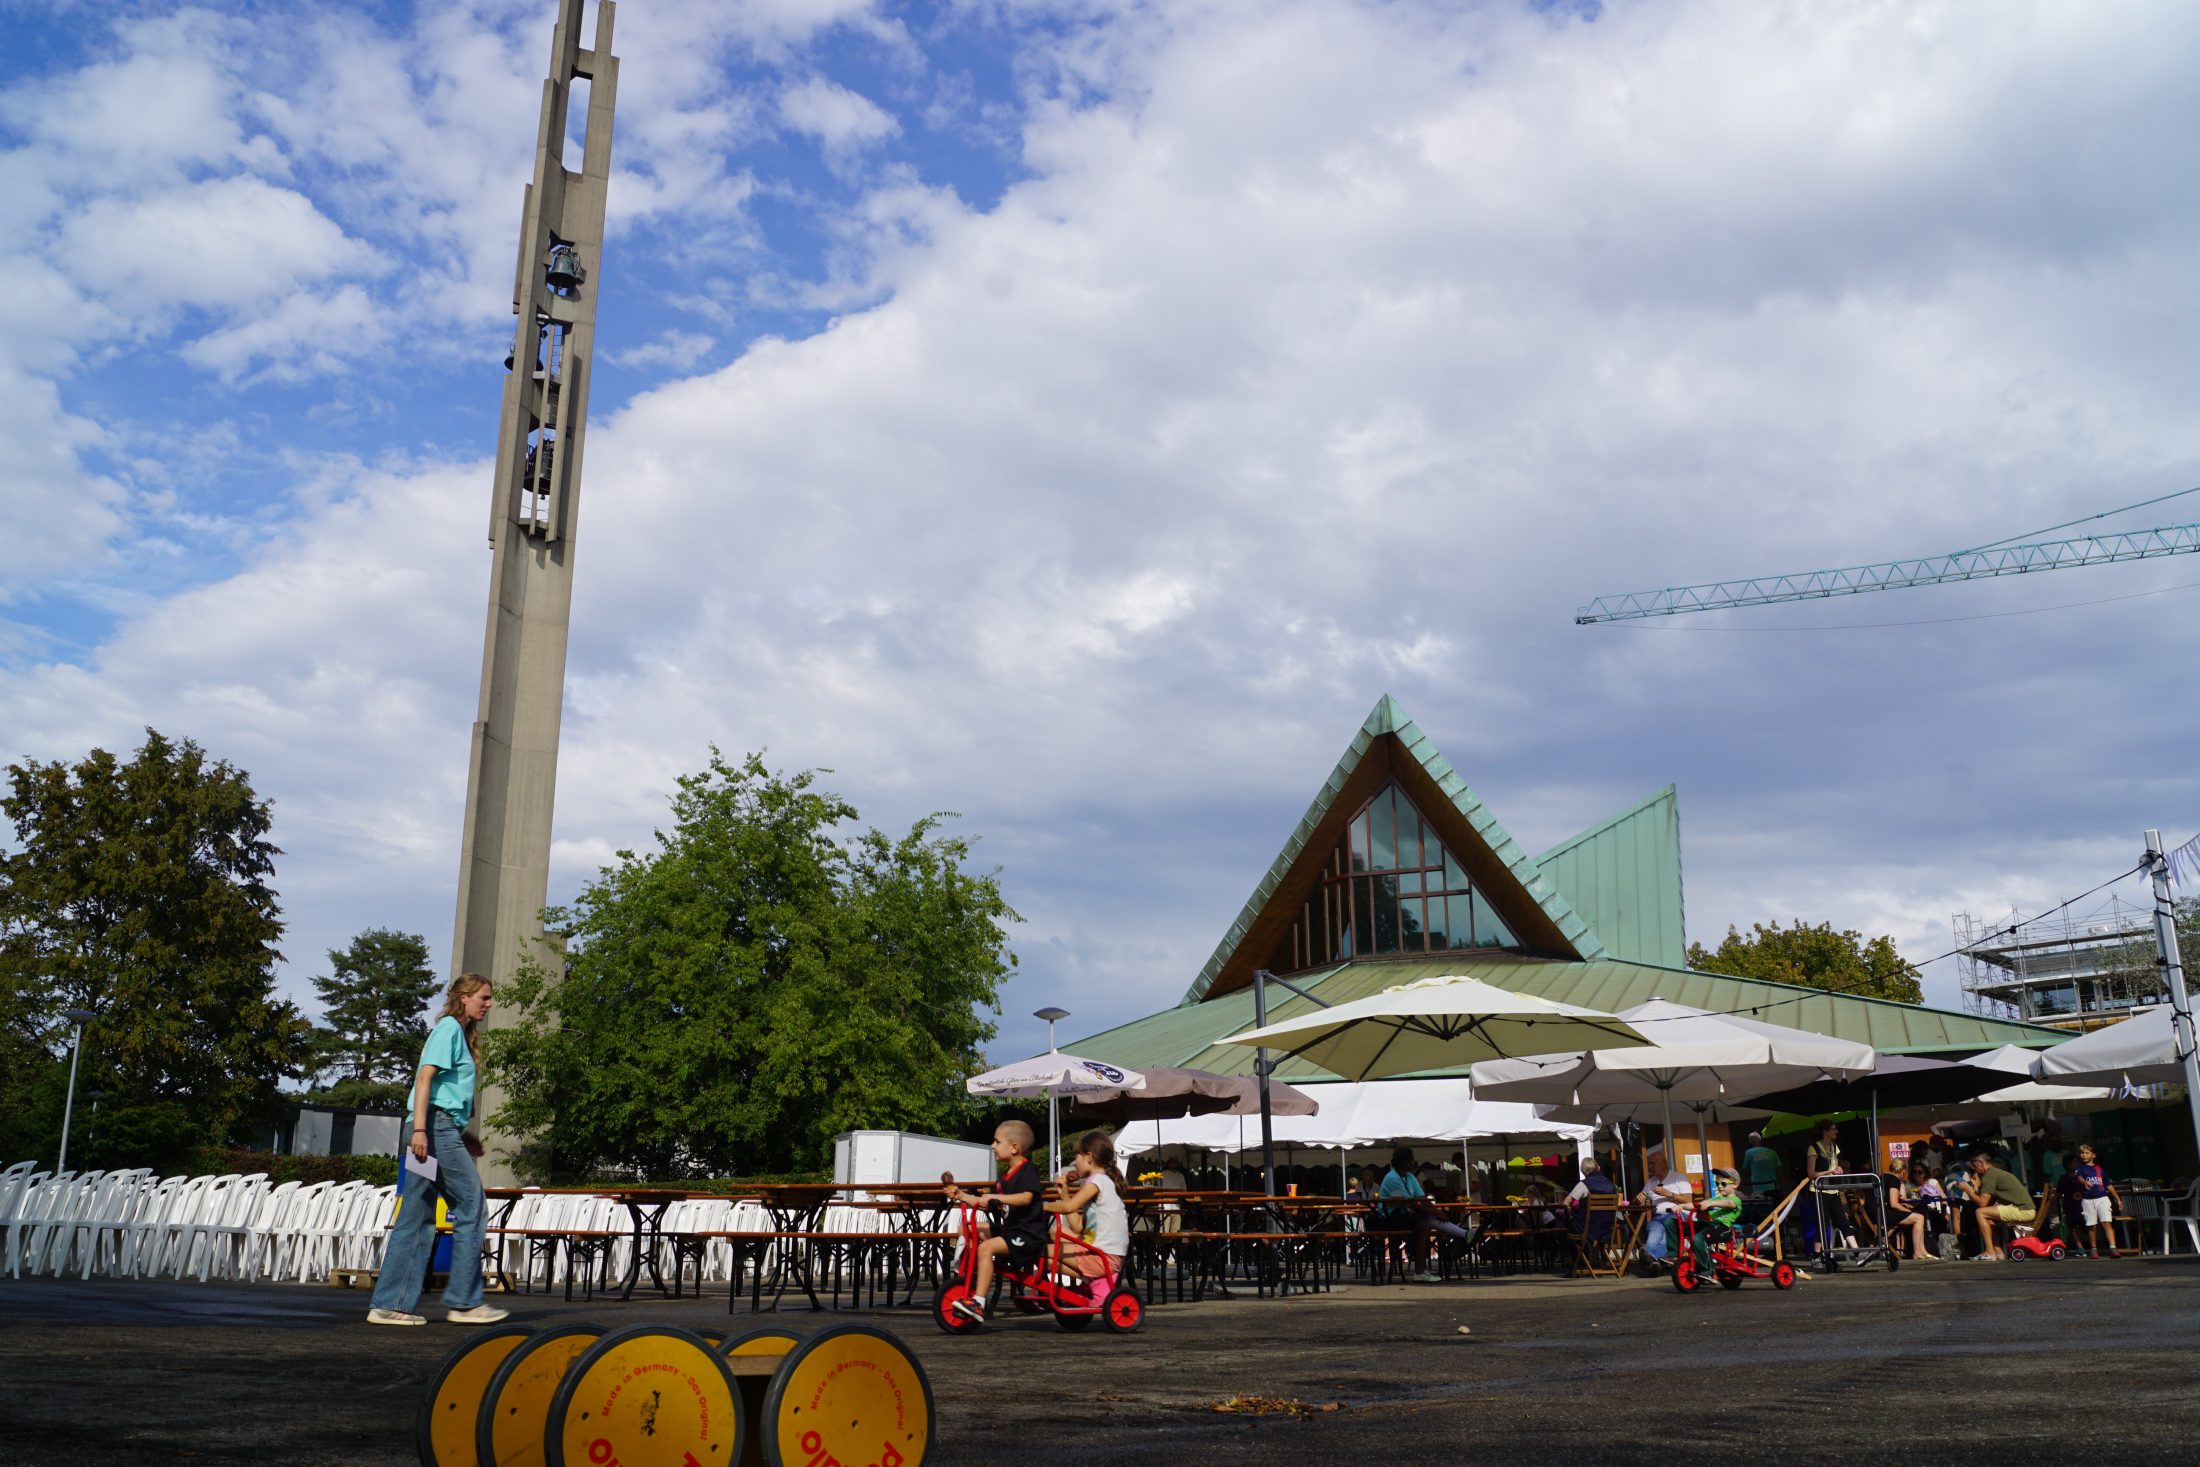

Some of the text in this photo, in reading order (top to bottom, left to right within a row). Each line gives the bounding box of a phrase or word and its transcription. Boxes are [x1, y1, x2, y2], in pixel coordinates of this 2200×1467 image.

[601, 1385, 622, 1417] Made
[623, 1374, 633, 1384] in
[634, 1363, 680, 1377] Germany
[687, 1377, 701, 1396] Das
[699, 1397, 709, 1441] Original
[811, 1381, 827, 1410] Made
[827, 1370, 837, 1379] in
[837, 1359, 877, 1372] Germany
[883, 1372, 897, 1389] Das
[894, 1390, 904, 1430] Original
